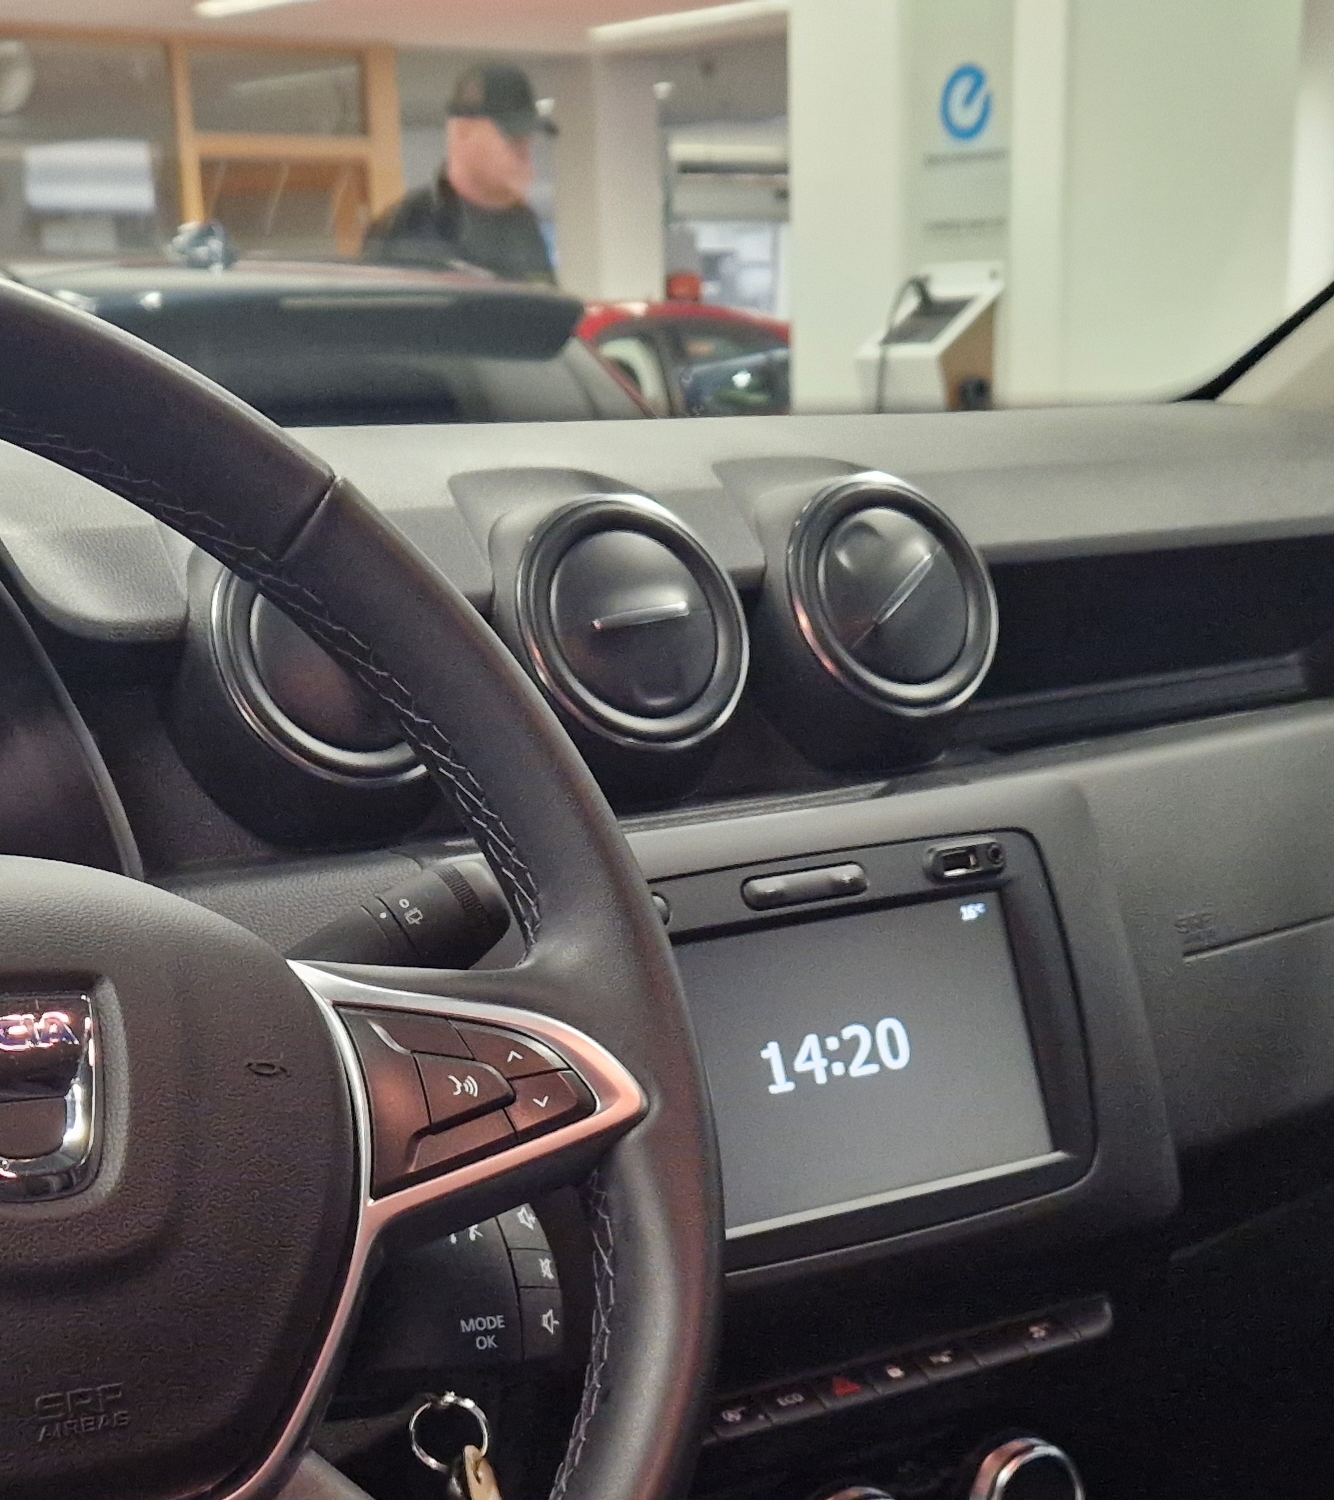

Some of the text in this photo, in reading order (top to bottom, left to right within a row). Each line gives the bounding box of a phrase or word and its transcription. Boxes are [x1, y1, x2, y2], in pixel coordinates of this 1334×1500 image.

[760, 1016, 912, 1096] 14:20
[459, 1313, 507, 1334] MODE
[475, 1334, 499, 1351] OK
